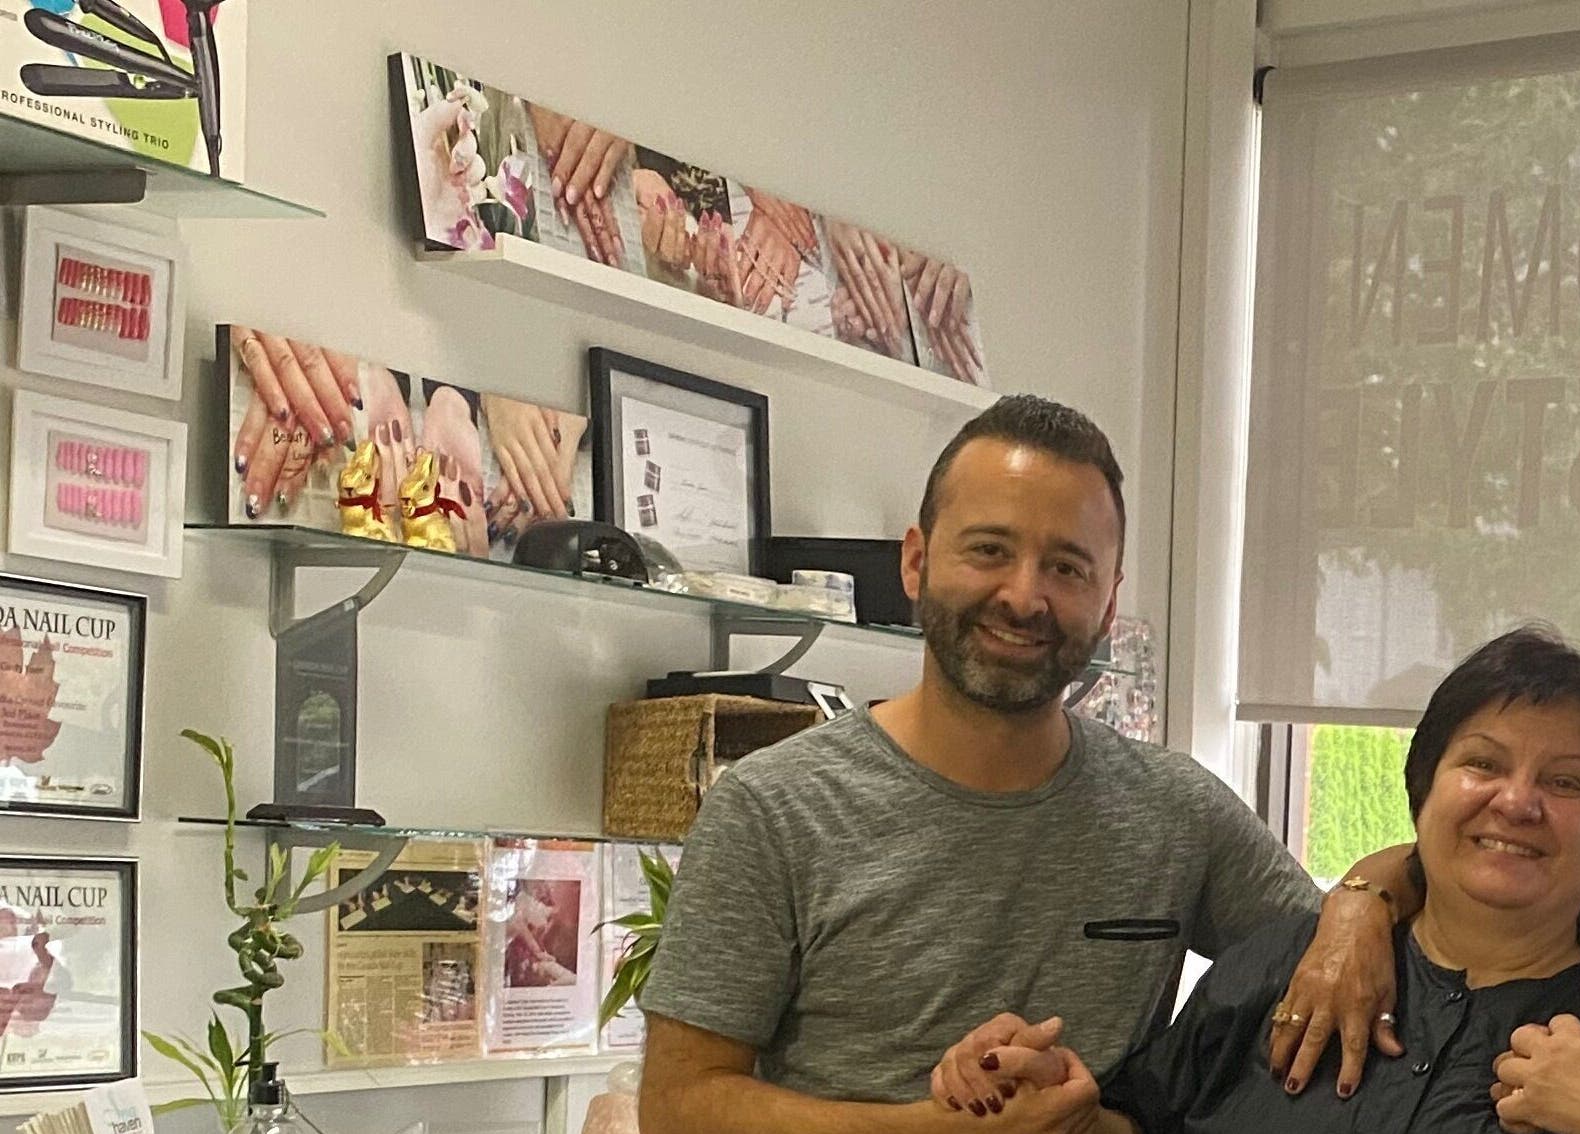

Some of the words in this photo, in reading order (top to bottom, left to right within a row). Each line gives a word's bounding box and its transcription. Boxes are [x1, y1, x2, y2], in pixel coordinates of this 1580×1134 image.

[90, 117, 140, 140] STYLING
[143, 133, 169, 149] TRIO
[23, 608, 71, 635] NAIL
[76, 616, 116, 640] CUP
[16, 886, 63, 907] NAIL
[68, 887, 107, 908] CUP
